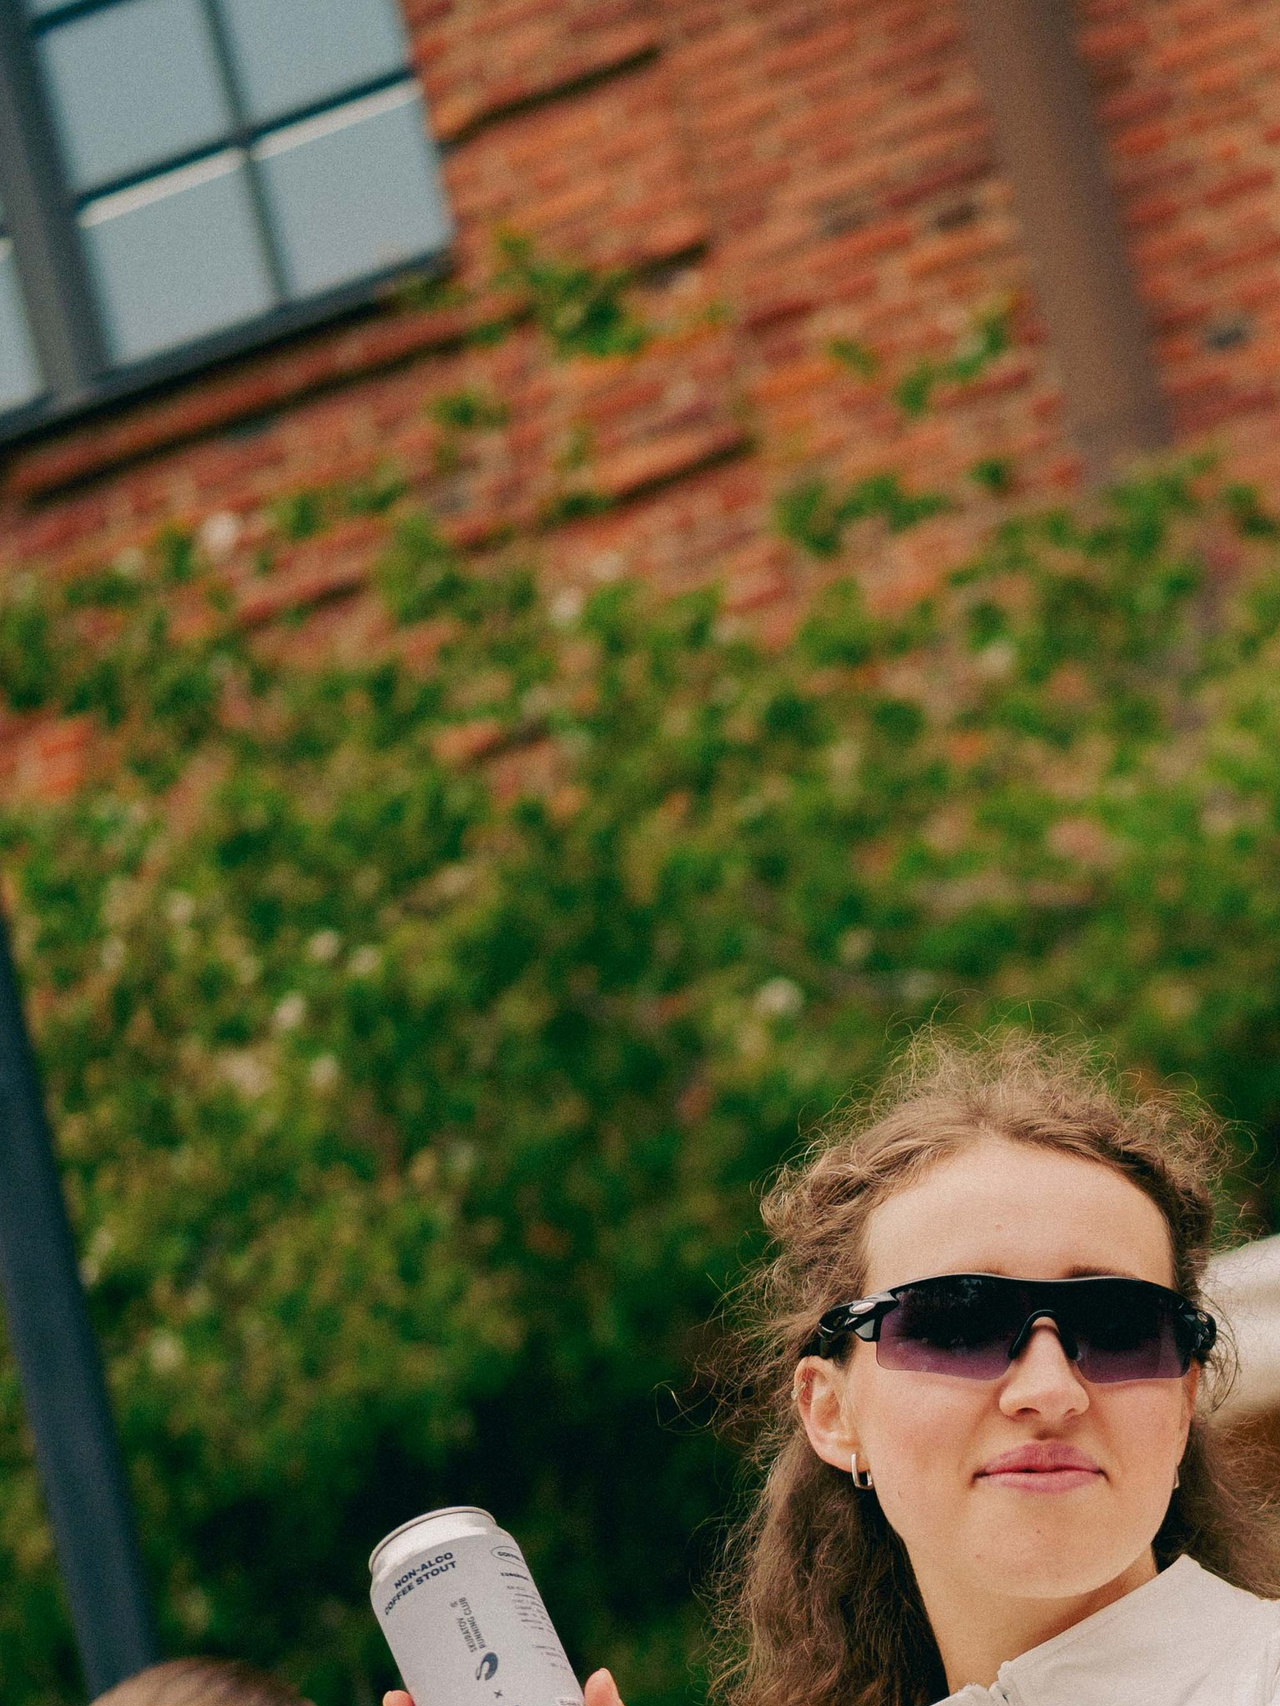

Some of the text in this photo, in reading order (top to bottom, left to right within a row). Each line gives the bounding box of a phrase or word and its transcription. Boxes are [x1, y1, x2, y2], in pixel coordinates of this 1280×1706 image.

[384, 1560, 457, 1616] COFFEE STOUT
[394, 1552, 454, 1590] NON-ALCO
[458, 1596, 473, 1616] CLUB
